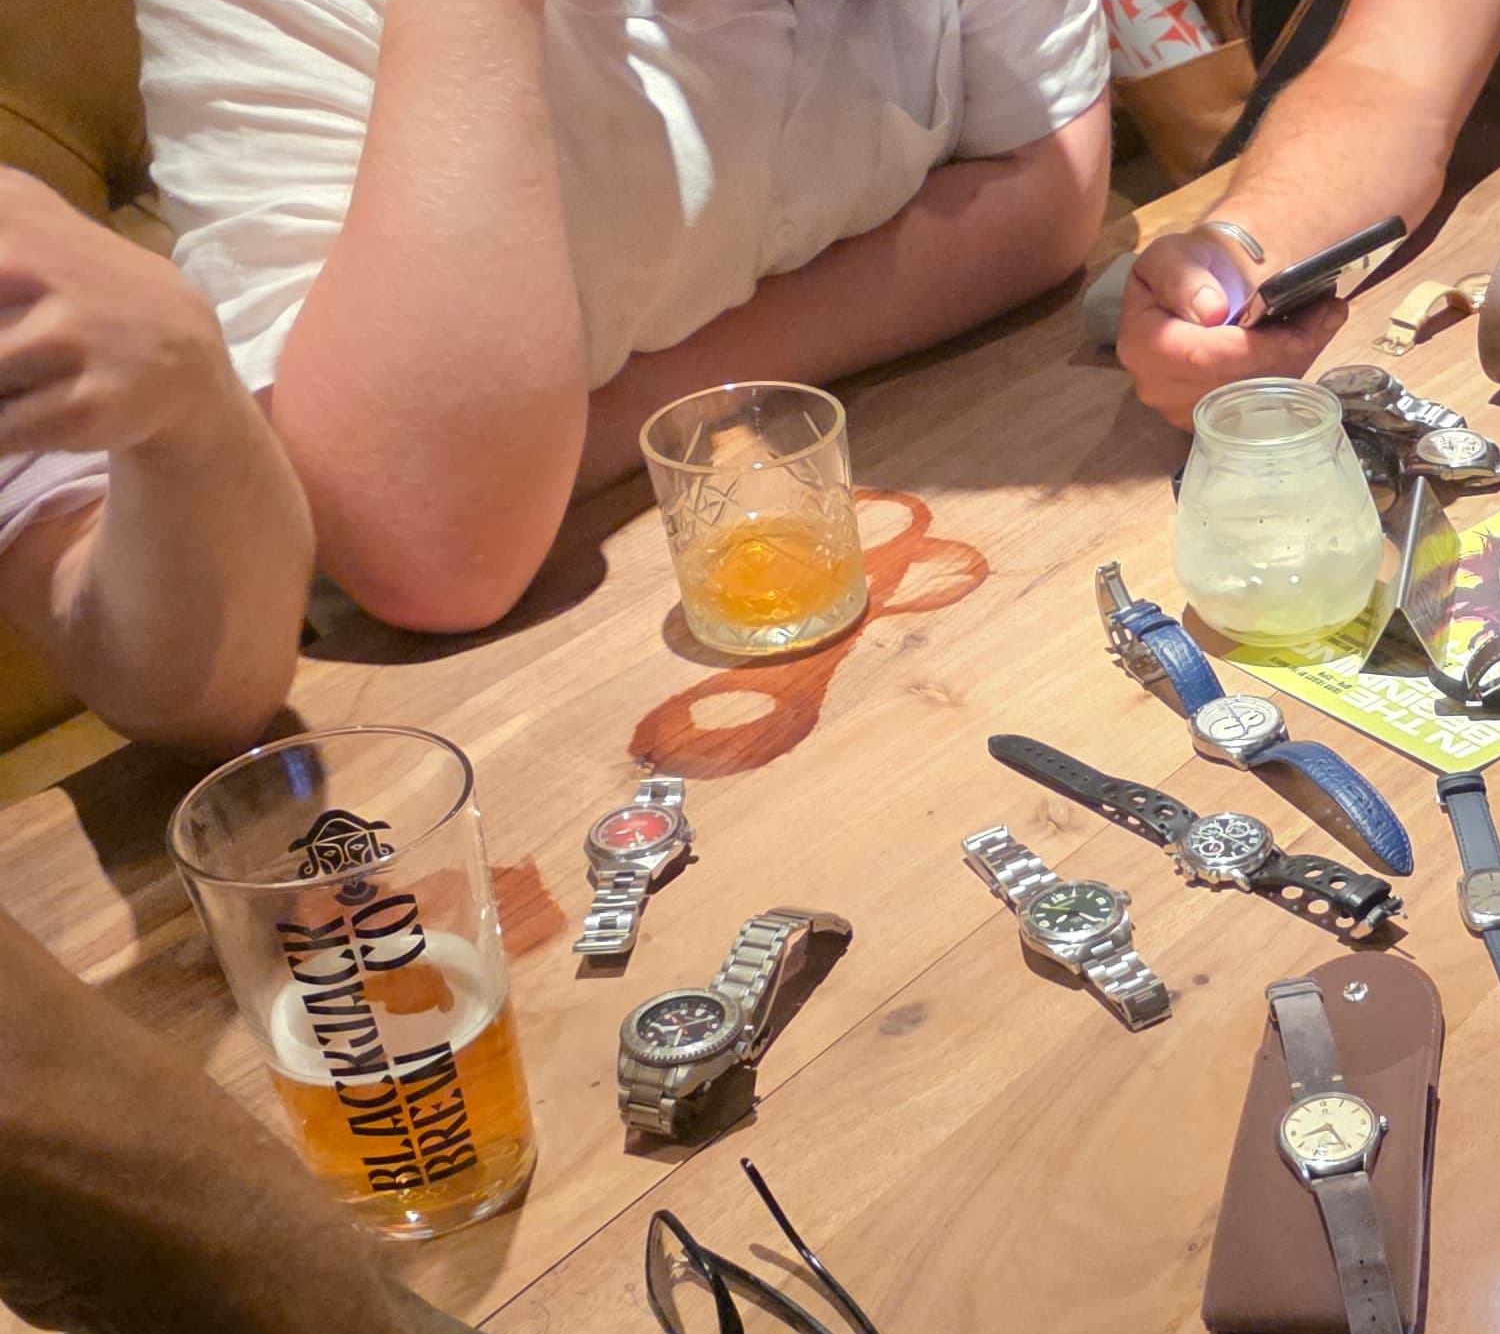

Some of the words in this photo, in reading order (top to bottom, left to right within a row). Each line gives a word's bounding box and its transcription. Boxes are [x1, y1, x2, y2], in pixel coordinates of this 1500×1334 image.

[1341, 686, 1426, 736] THE
[1424, 730, 1480, 759] IN
[351, 893, 427, 972] CO
[276, 916, 425, 1192] BLACKJACK
[393, 1041, 478, 1183] BREW
